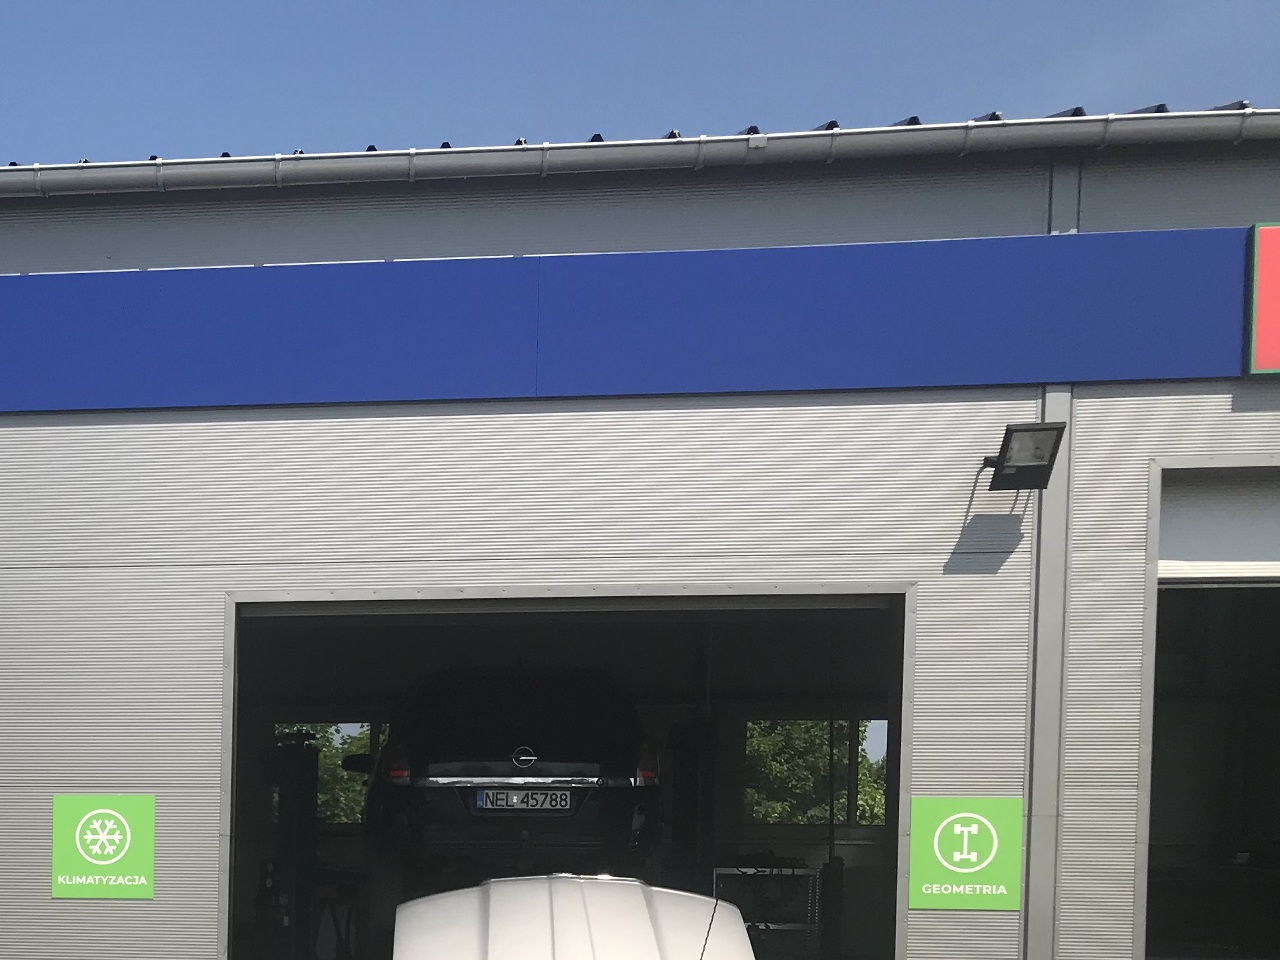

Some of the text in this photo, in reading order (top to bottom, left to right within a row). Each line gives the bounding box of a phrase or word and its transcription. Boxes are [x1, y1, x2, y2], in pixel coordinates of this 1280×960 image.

[484, 791, 515, 808] NEL
[520, 791, 569, 808] 45788
[57, 875, 148, 886] KLIMATYZACJA
[921, 883, 1008, 895] GEOMETRIA
